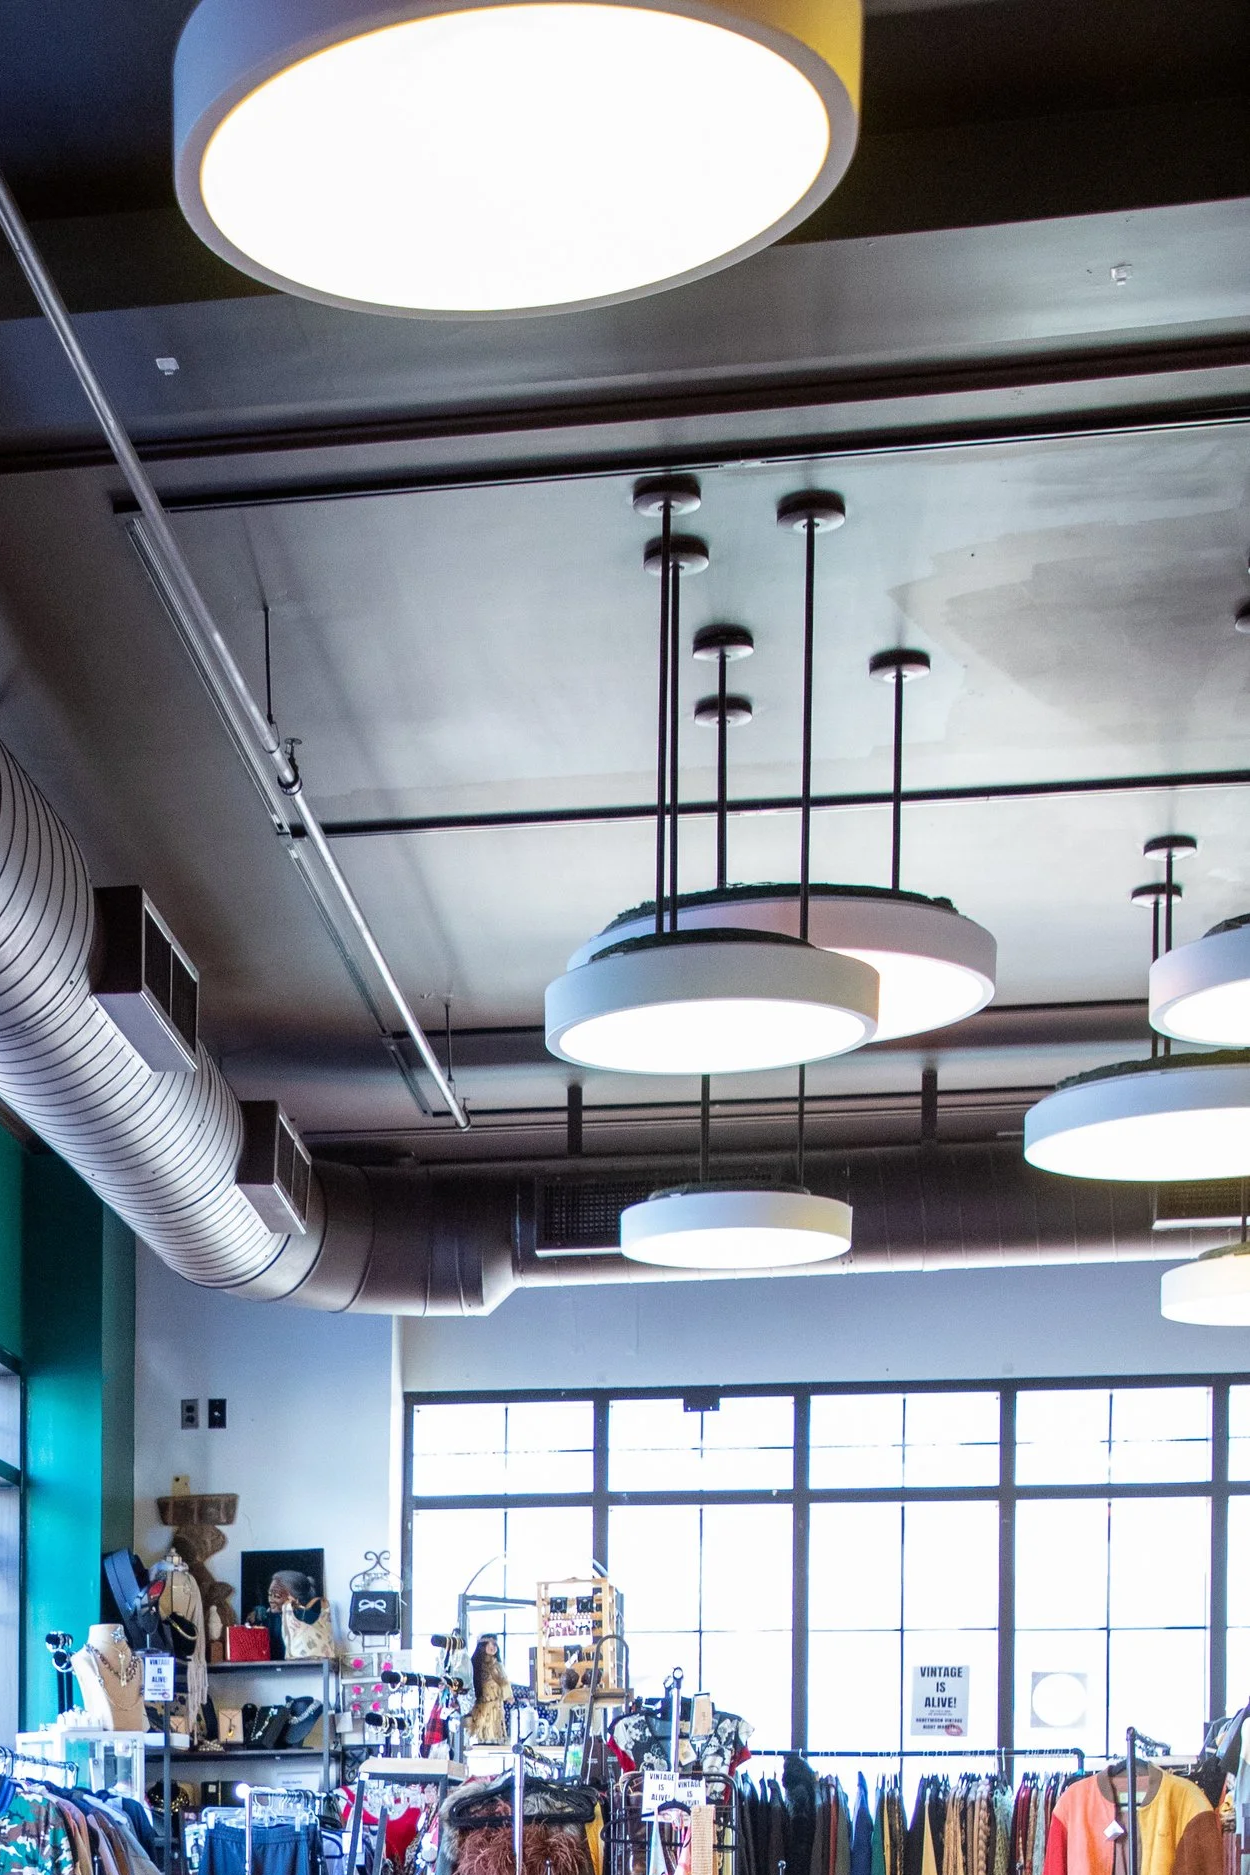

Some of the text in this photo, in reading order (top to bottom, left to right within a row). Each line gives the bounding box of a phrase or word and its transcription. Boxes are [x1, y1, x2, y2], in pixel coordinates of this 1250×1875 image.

[920, 1666, 963, 1678] VINTAGE
[936, 1682, 946, 1693] IS
[924, 1697, 957, 1708] ALIVE!
[650, 1773, 674, 1781] VINTAGE
[678, 1780, 701, 1788] VINTAGE
